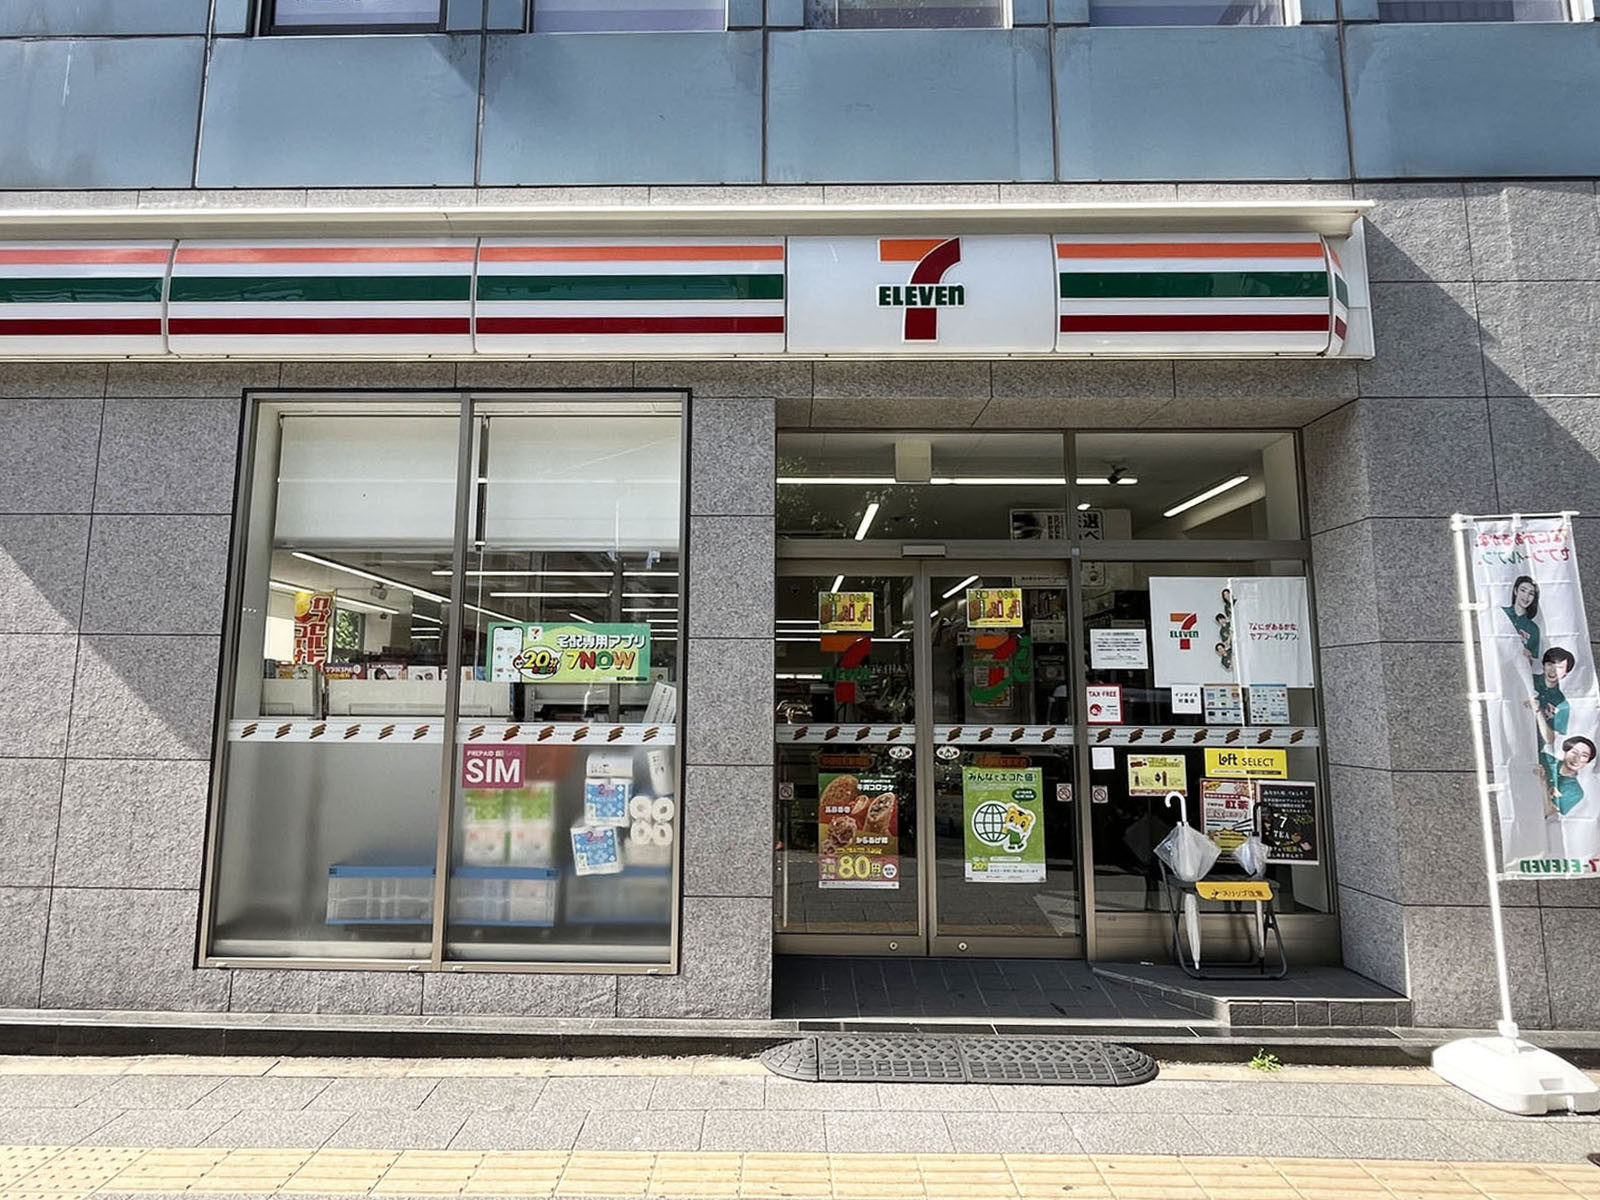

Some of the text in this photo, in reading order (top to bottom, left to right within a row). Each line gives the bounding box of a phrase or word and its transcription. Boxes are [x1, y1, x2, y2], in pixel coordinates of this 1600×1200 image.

[878, 284, 965, 306] ELEVEN
[879, 237, 961, 341] 7
[1169, 630, 1199, 638] ELEVEN
[566, 650, 636, 670] 7NOW
[465, 758, 521, 783] SIM
[1242, 758, 1275, 767] SELECT
[1279, 816, 1288, 828] 7
[1273, 830, 1290, 839] TEA
